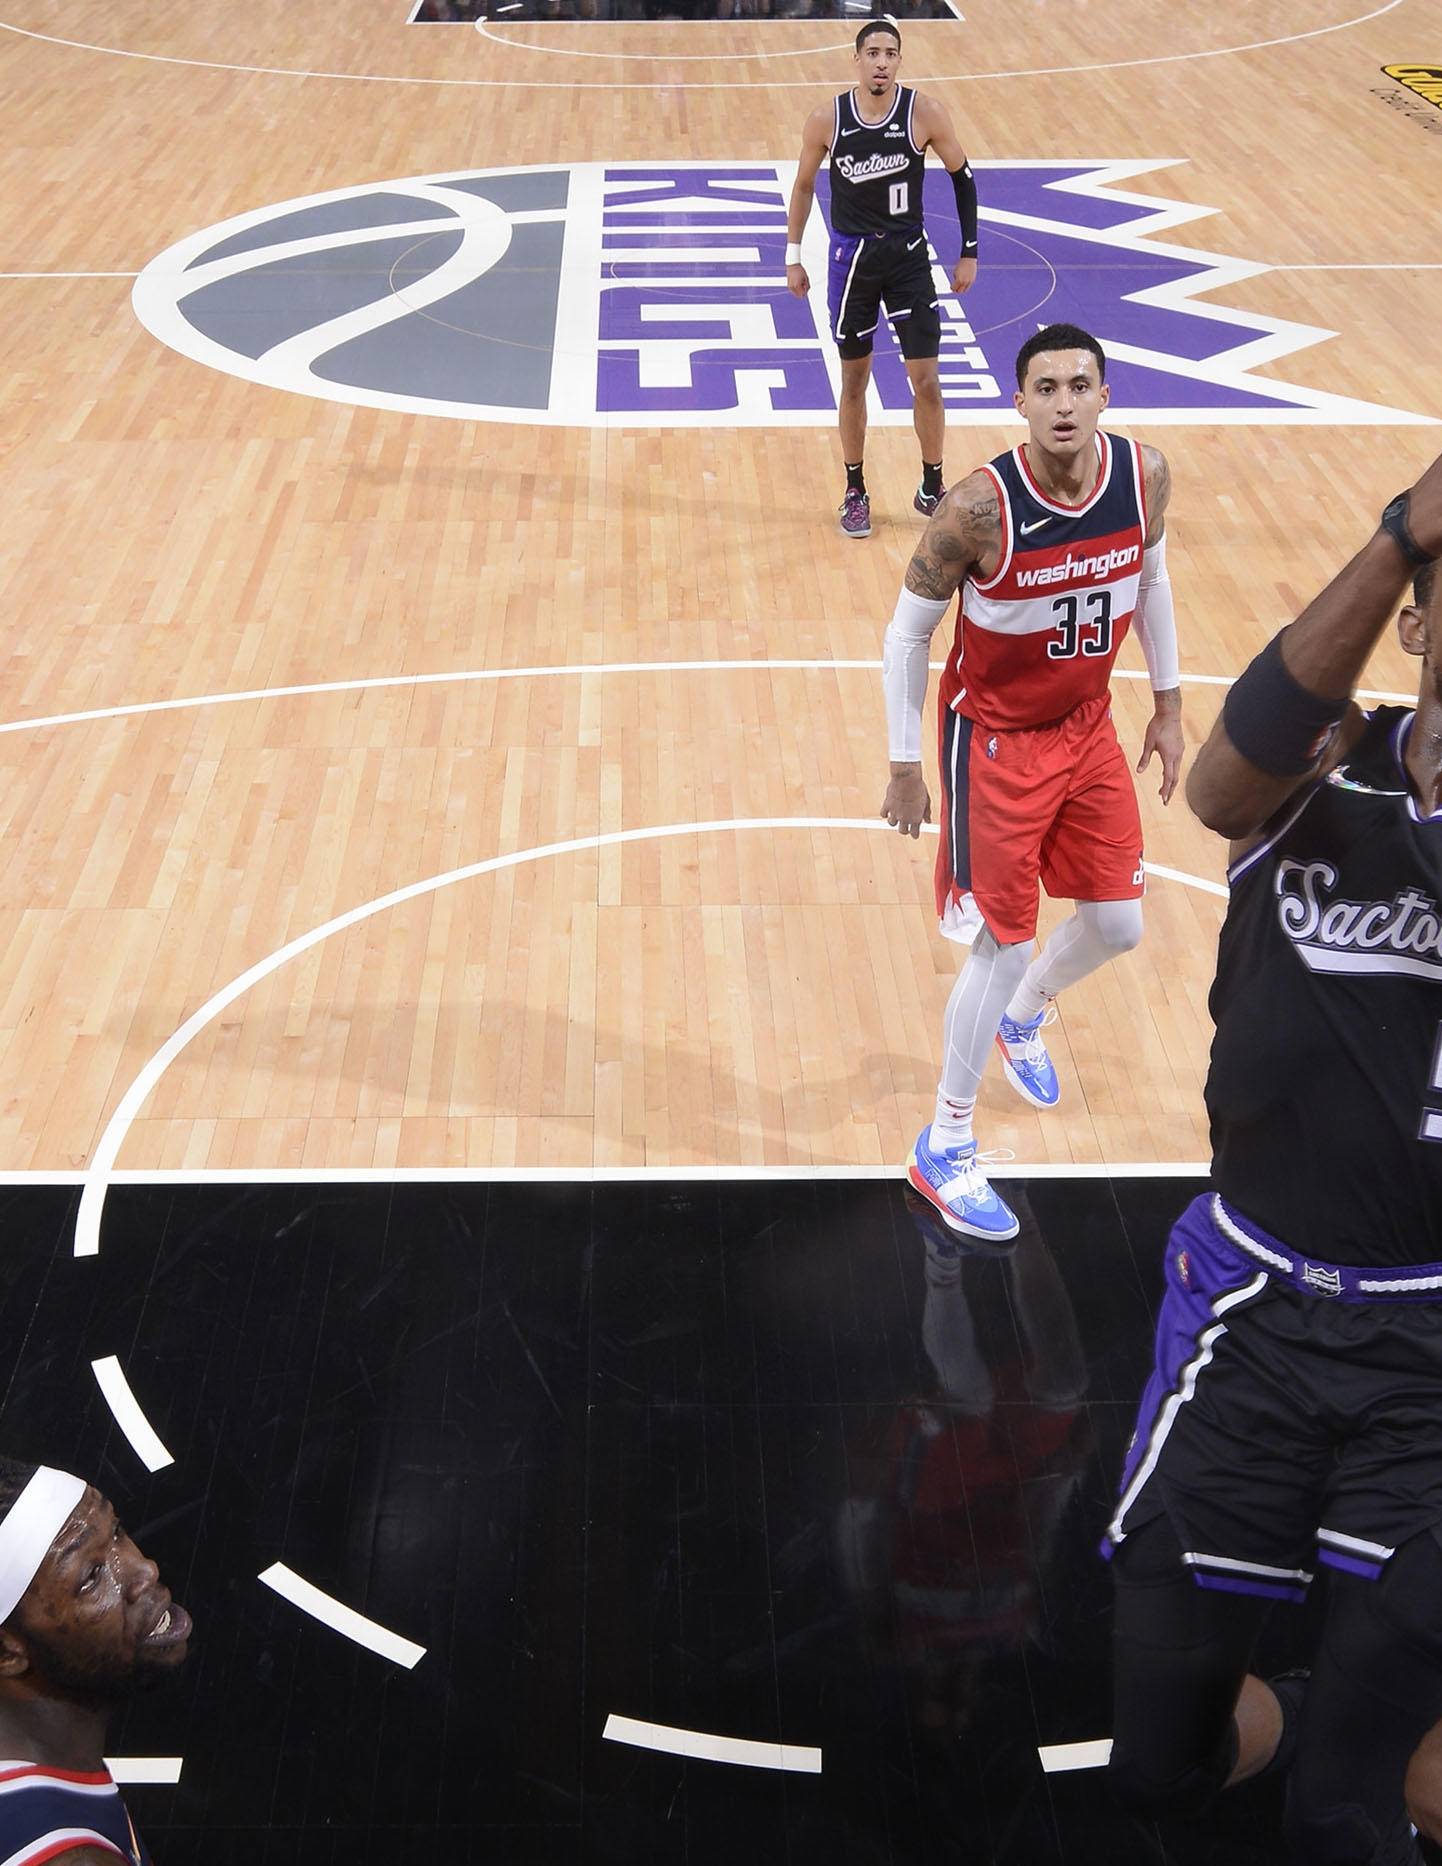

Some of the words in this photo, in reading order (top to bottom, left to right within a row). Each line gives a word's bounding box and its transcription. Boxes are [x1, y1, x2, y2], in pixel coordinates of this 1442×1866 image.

[835, 152, 910, 184] Sactown
[889, 181, 909, 216] 0
[596, 168, 838, 412] KINGS
[1015, 542, 1139, 588] washington
[1047, 590, 1113, 660] 33
